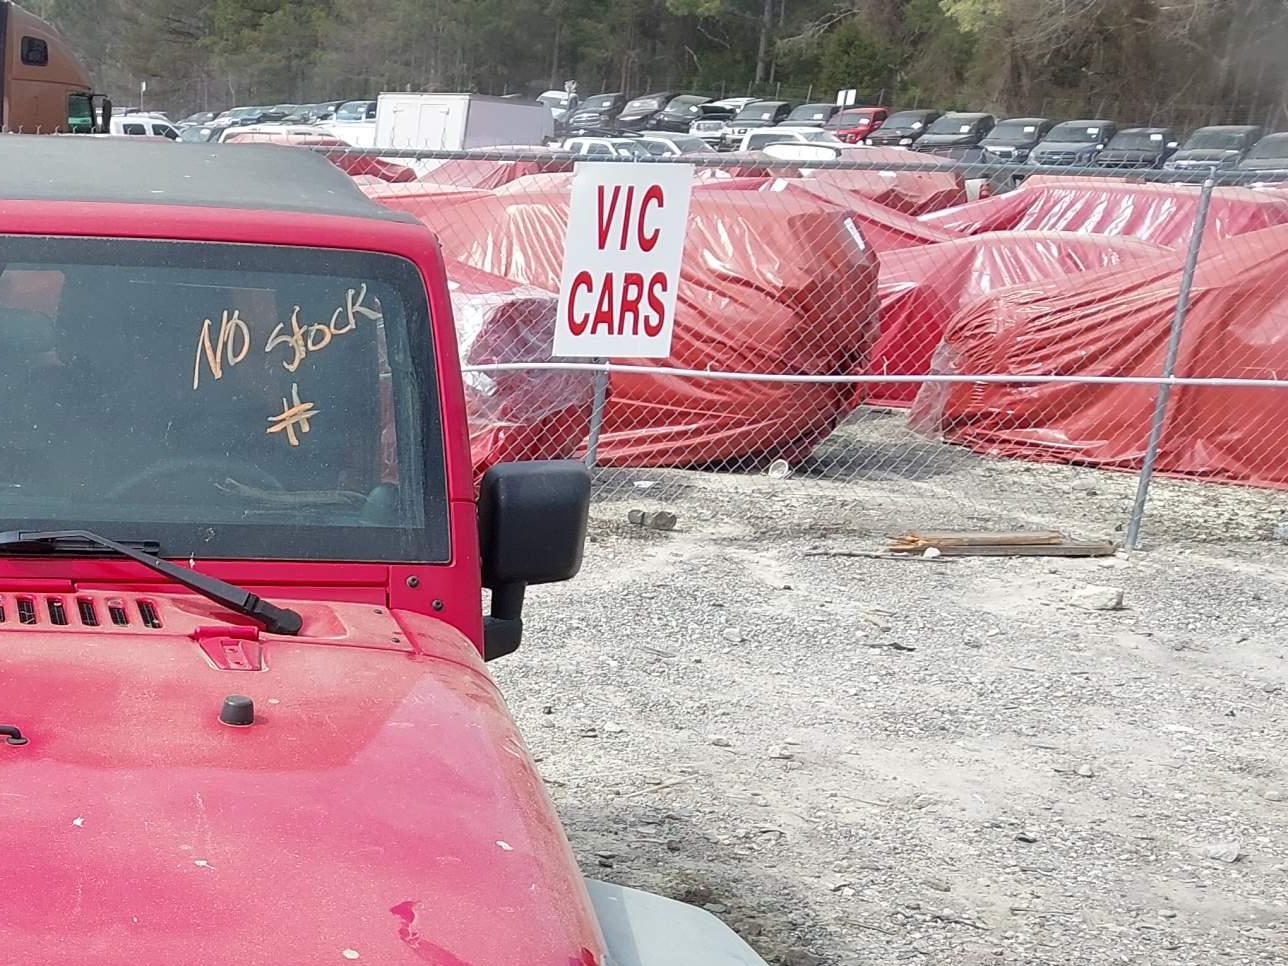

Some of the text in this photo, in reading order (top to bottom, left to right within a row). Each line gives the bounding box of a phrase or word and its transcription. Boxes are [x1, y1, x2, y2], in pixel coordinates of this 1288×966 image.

[597, 184, 665, 253] VIC
[567, 270, 668, 338] CARS
[266, 383, 320, 446] #
